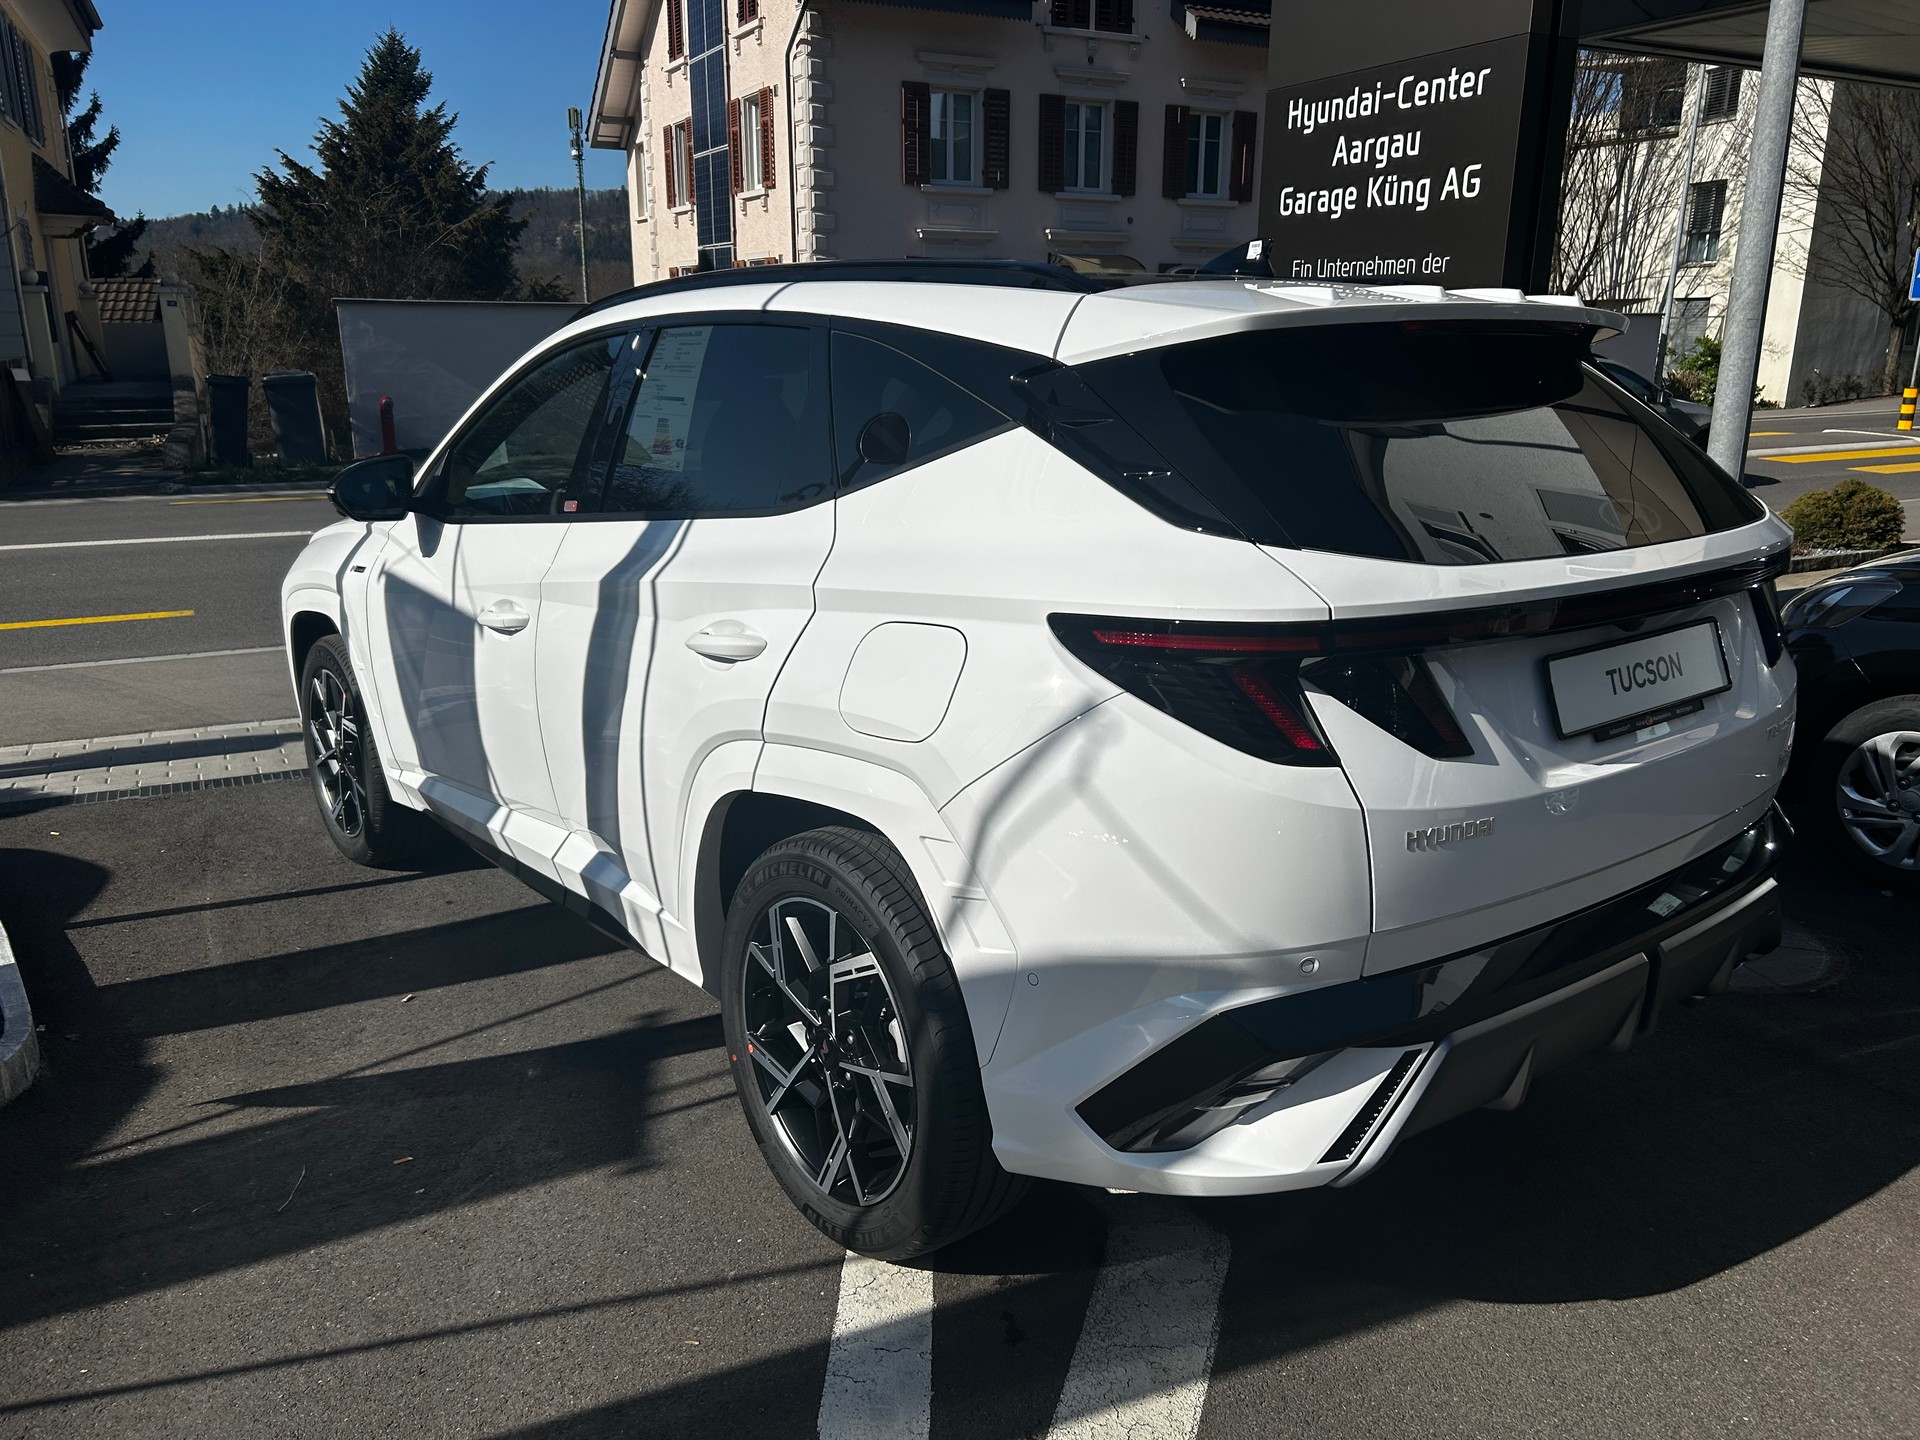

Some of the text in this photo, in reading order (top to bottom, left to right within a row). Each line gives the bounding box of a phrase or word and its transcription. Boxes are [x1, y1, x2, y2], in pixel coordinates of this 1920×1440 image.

[1287, 67, 1491, 134] Hyundai-Center
[1332, 131, 1421, 168] Aargau
[1280, 163, 1482, 219] Garage Küng AG
[1317, 256, 1416, 278] Unternehmen
[1422, 252, 1451, 274] der
[1605, 652, 1683, 696] TUCSON
[1406, 817, 1495, 851] HYUNDAI
[754, 861, 828, 887] MICHELIN
[835, 887, 869, 924] PRIMACY
